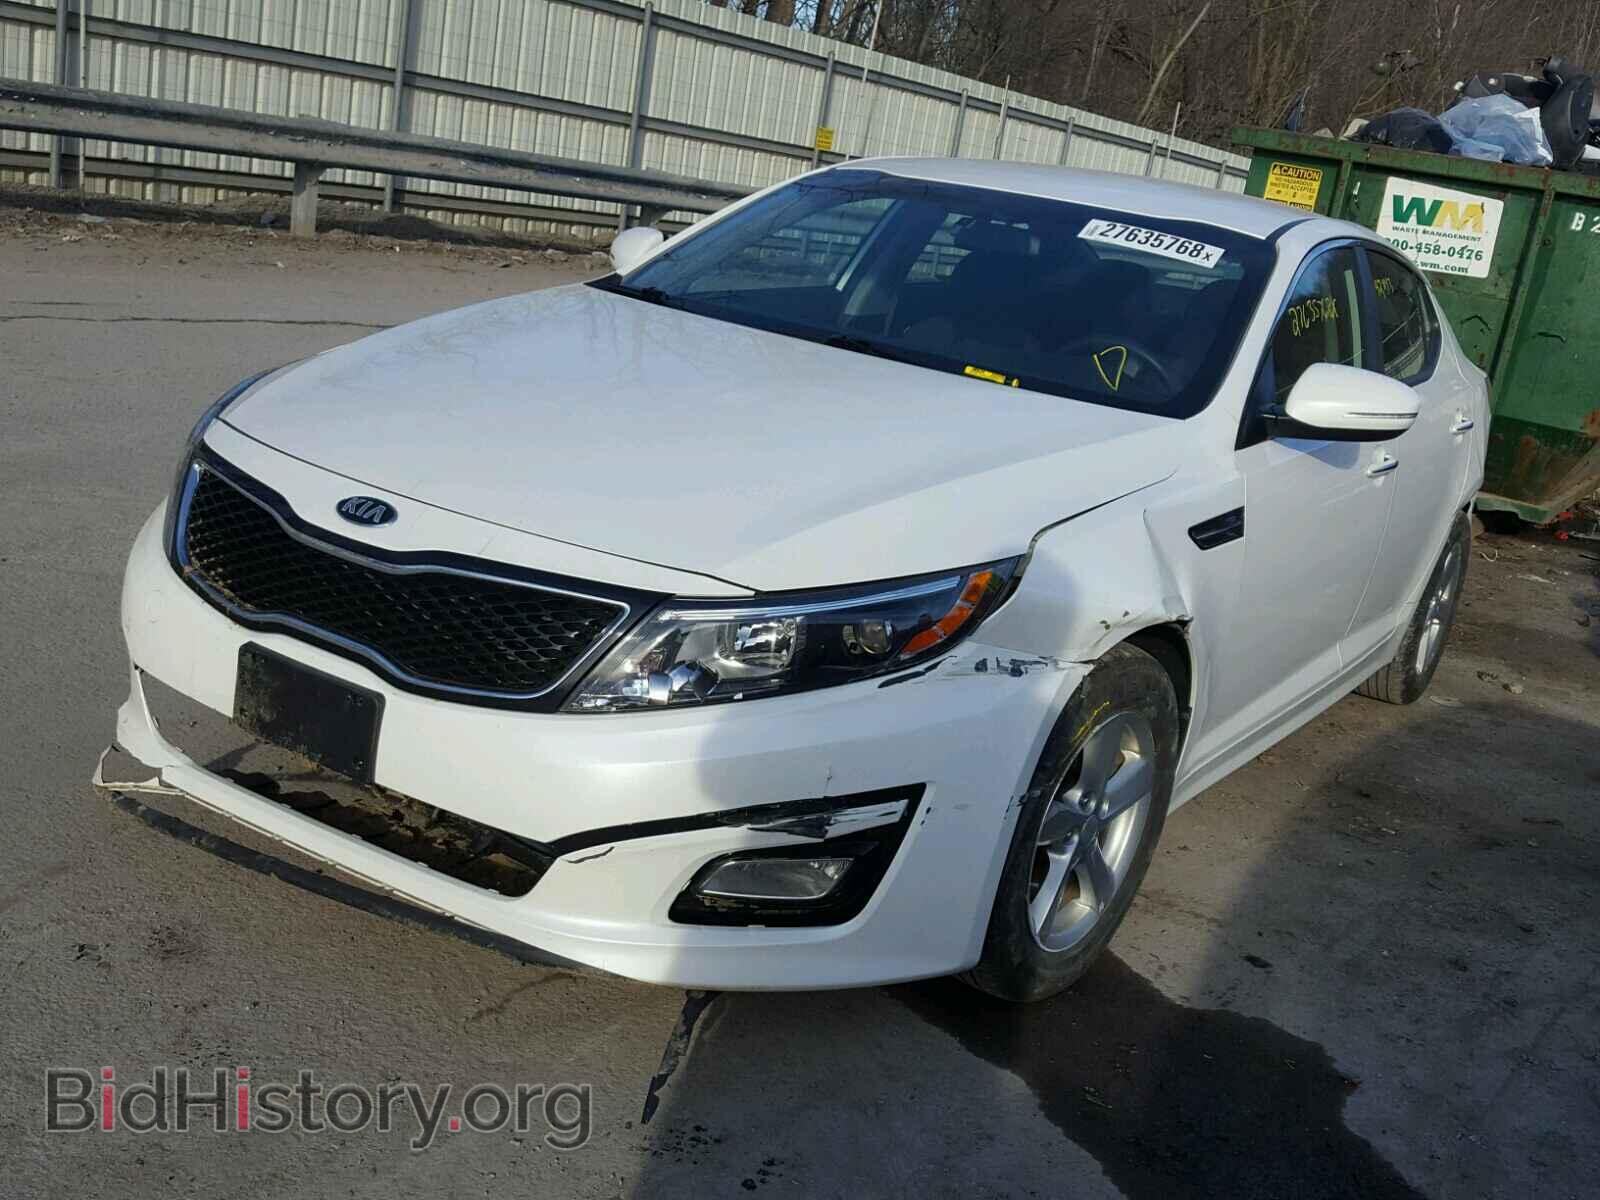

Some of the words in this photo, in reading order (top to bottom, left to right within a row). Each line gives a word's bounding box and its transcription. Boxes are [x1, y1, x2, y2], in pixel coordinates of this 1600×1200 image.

[1280, 166, 1320, 180] CAUTION
[1392, 194, 1485, 234] WM
[1571, 212, 1586, 231] B
[1392, 226, 1419, 234] WASTE
[1422, 230, 1482, 242] MANAGEMENT
[1415, 260, 1469, 274] .wm.com
[341, 497, 386, 523] KIA
